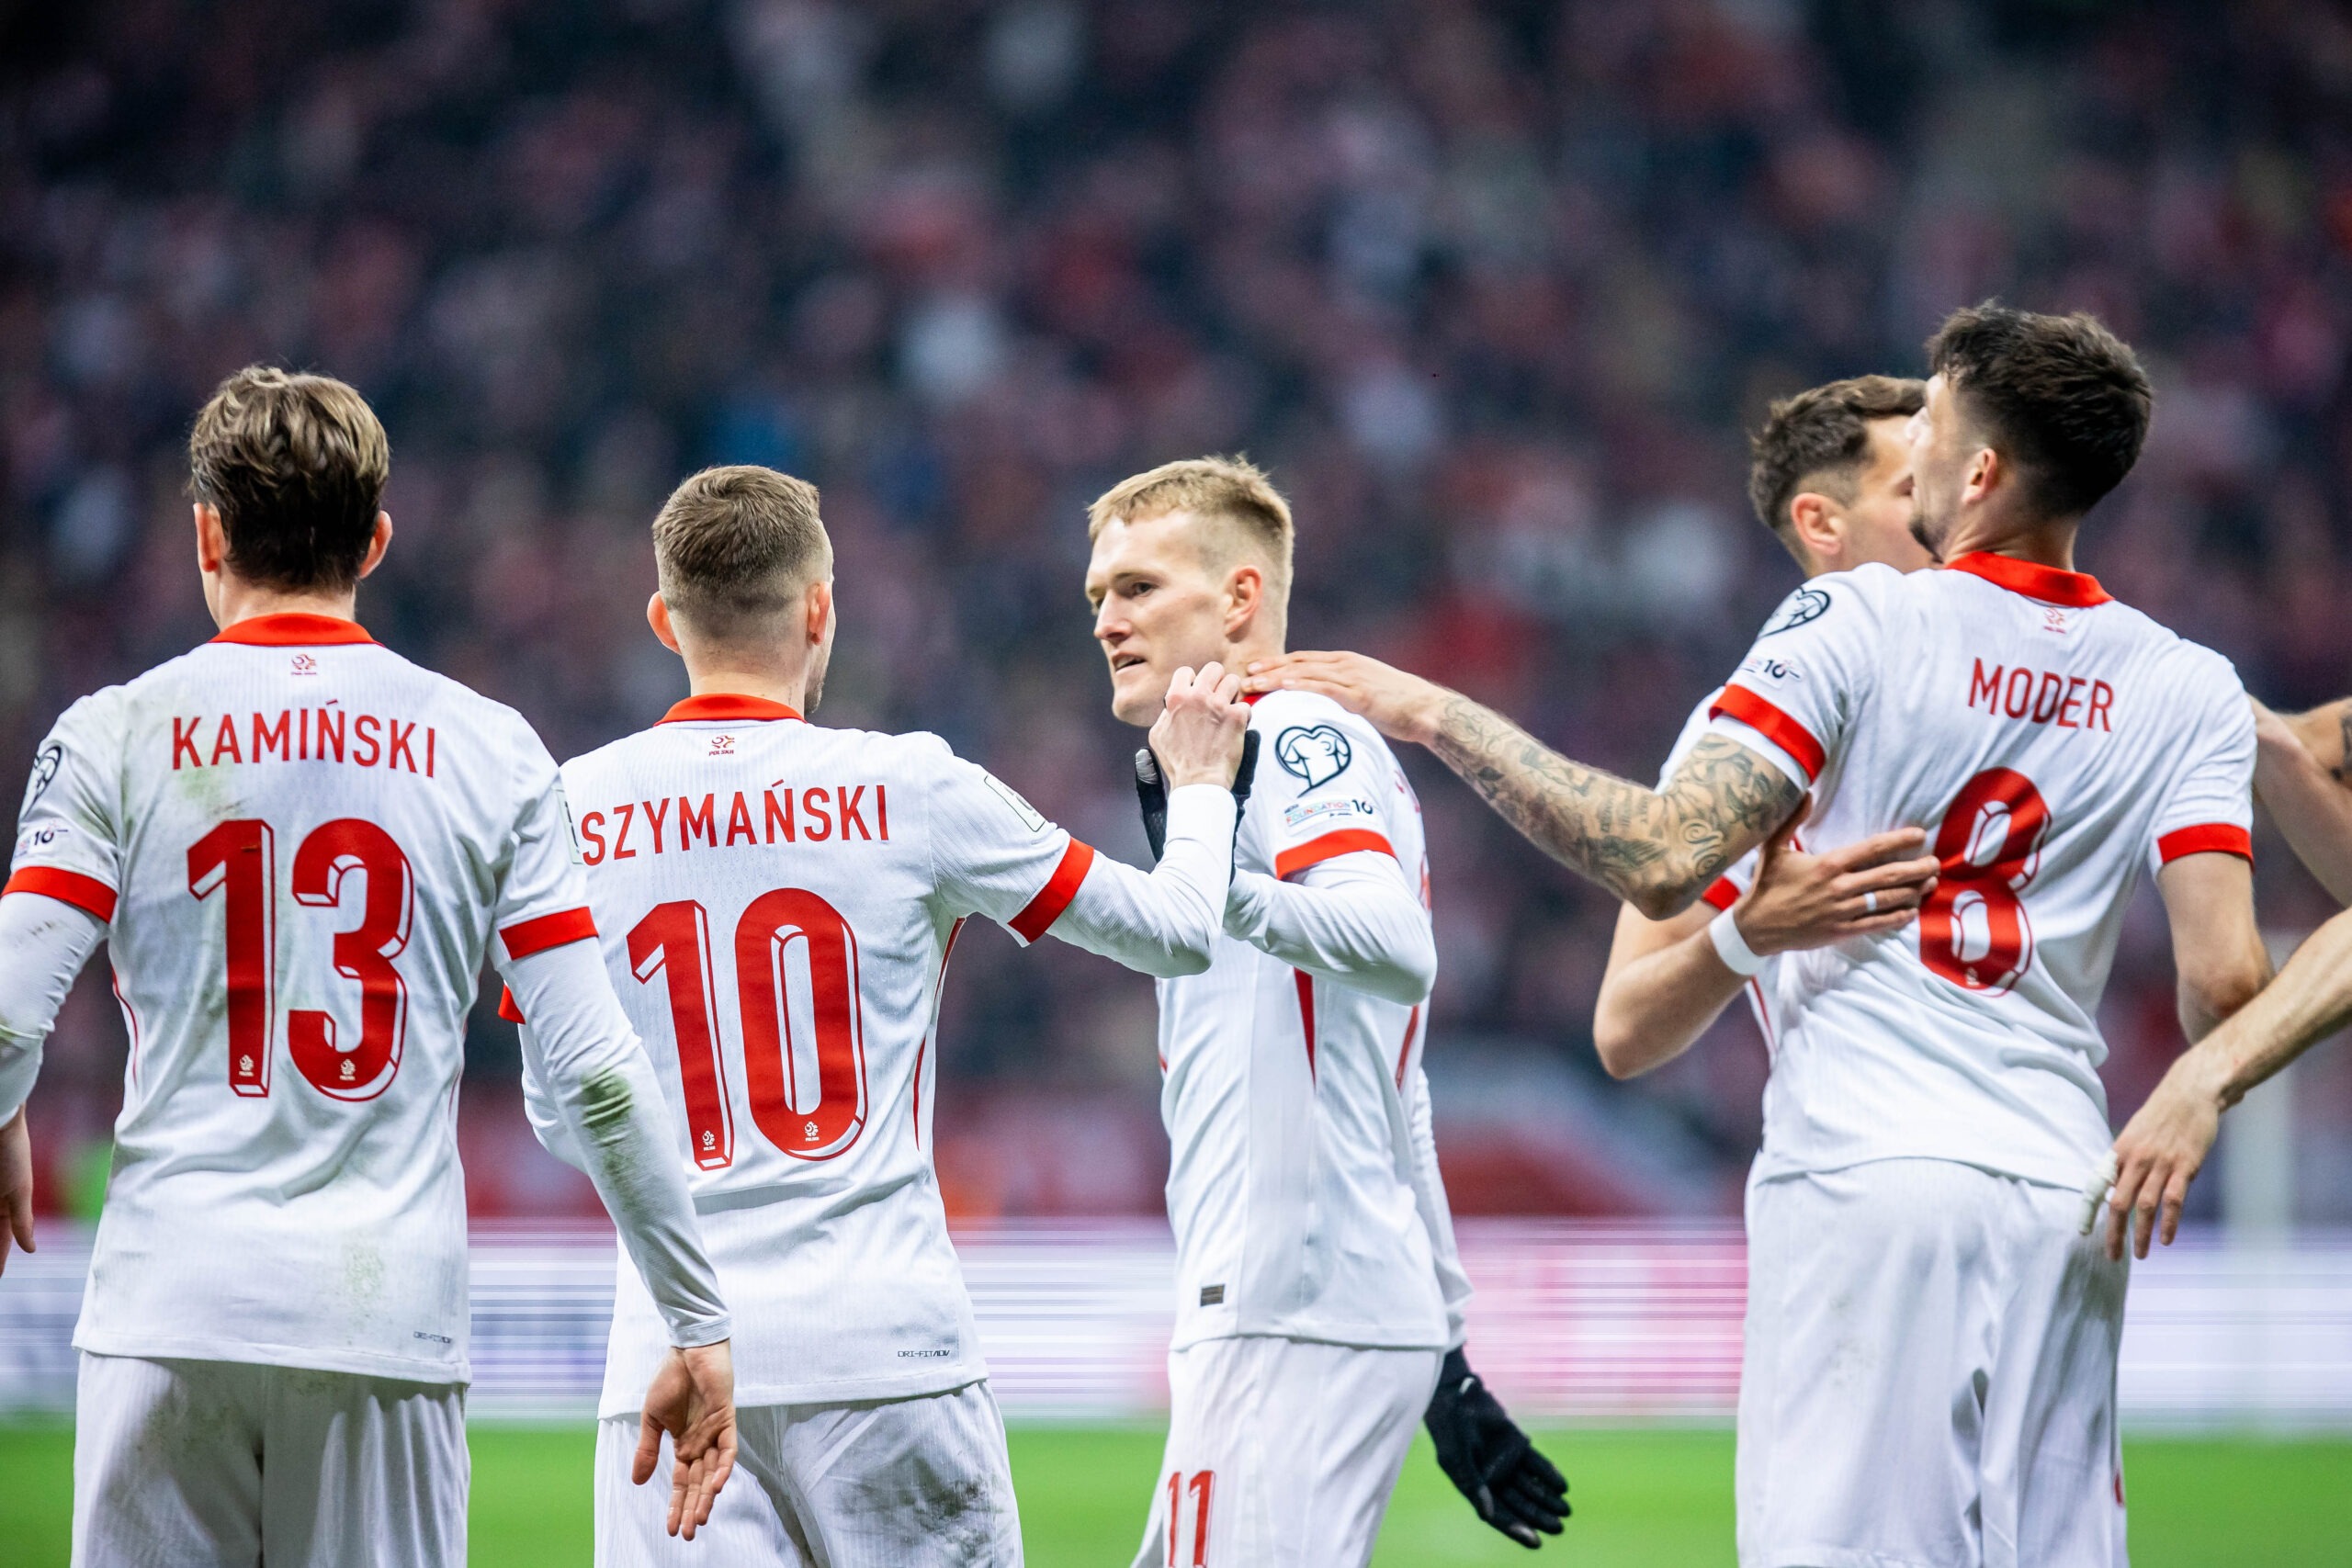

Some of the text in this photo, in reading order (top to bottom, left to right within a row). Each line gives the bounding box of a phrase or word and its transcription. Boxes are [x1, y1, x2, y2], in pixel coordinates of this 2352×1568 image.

[172, 699, 435, 778] KAMIŃSKI
[1969, 658, 2113, 732] MODER
[582, 779, 889, 866] SZYMAŃSKI
[1918, 766, 2052, 997] 8
[187, 818, 413, 1102] 13
[627, 887, 868, 1172] 10
[1167, 1470, 1216, 1568] 11
